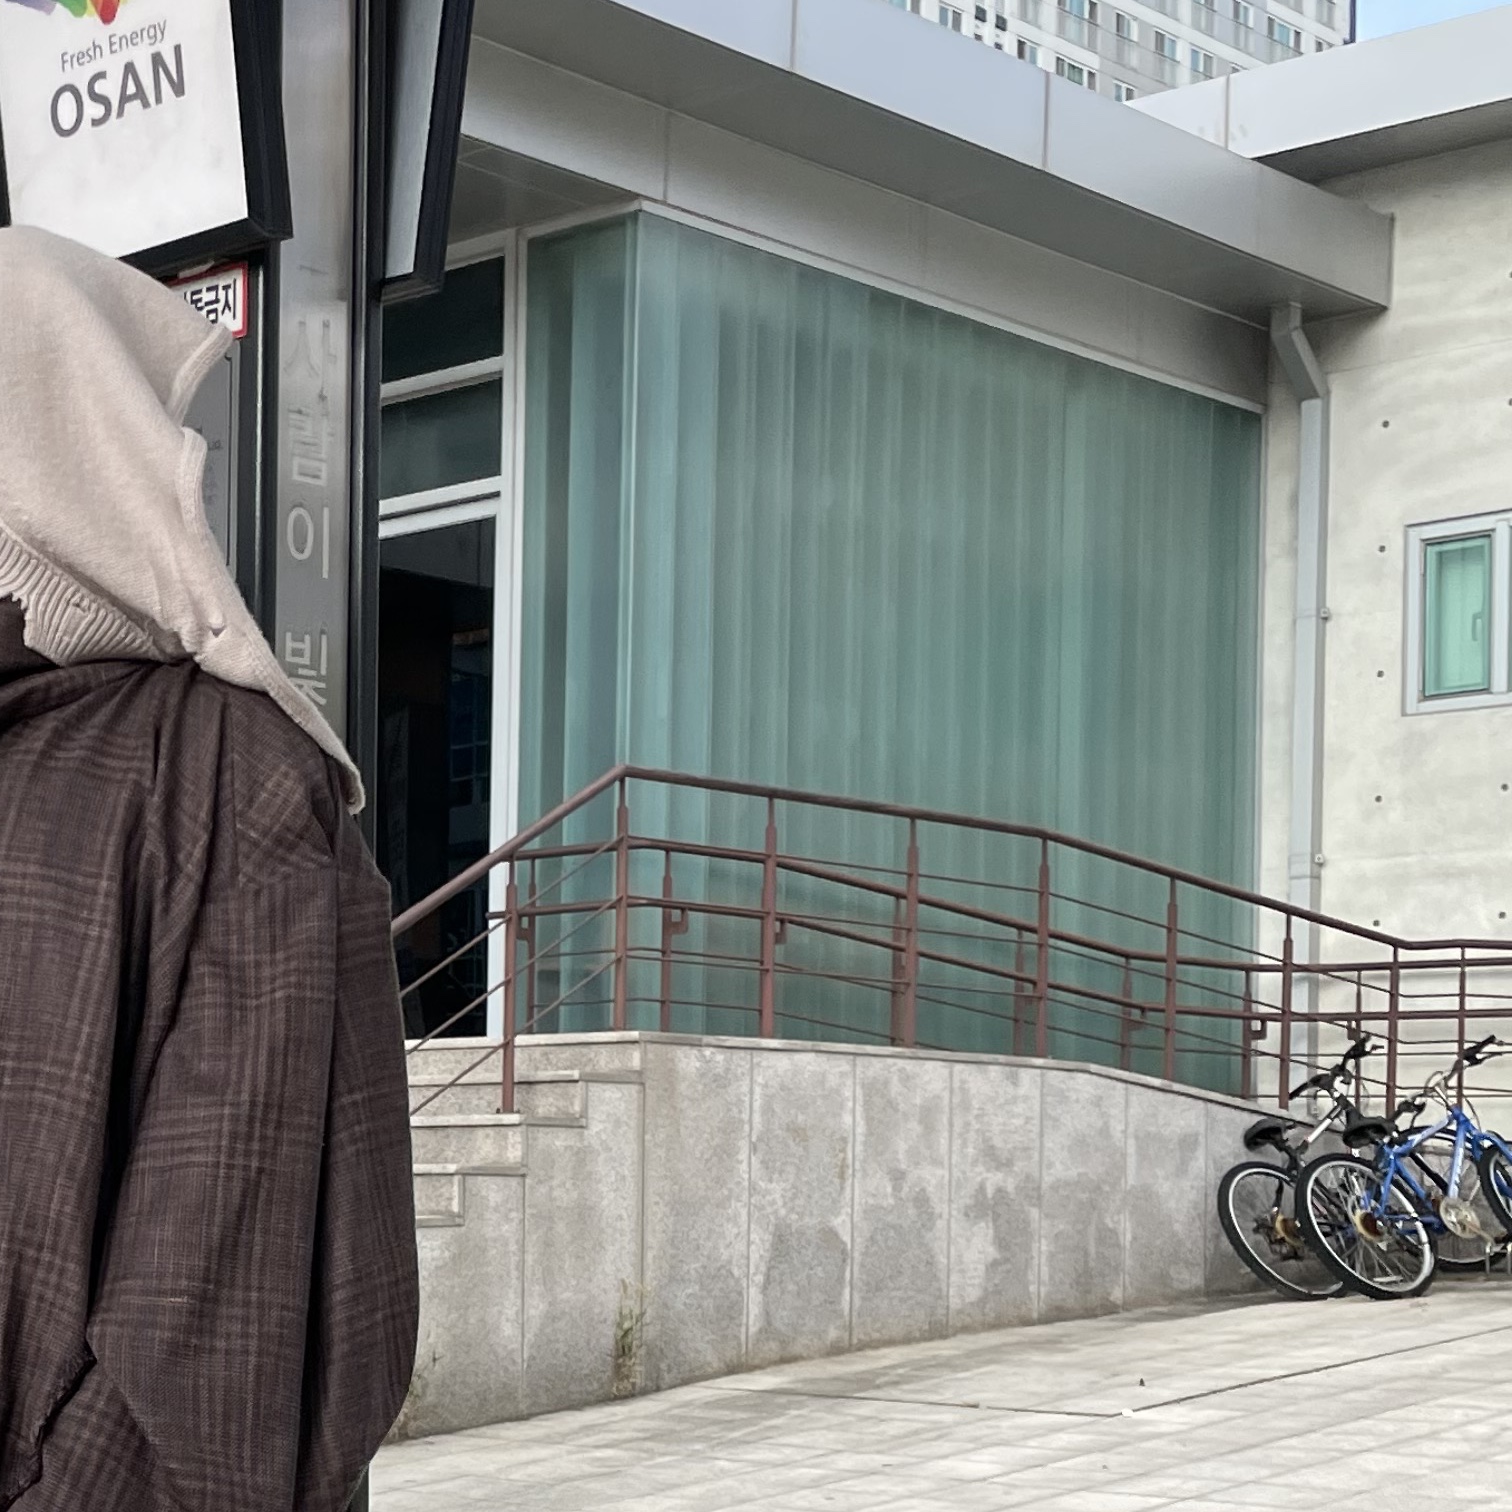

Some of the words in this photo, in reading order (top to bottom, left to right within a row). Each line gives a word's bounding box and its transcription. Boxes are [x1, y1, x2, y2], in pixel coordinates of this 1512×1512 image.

[60, 38, 103, 73] Fresh
[108, 19, 167, 55] Energy
[50, 43, 185, 138] OSAN
